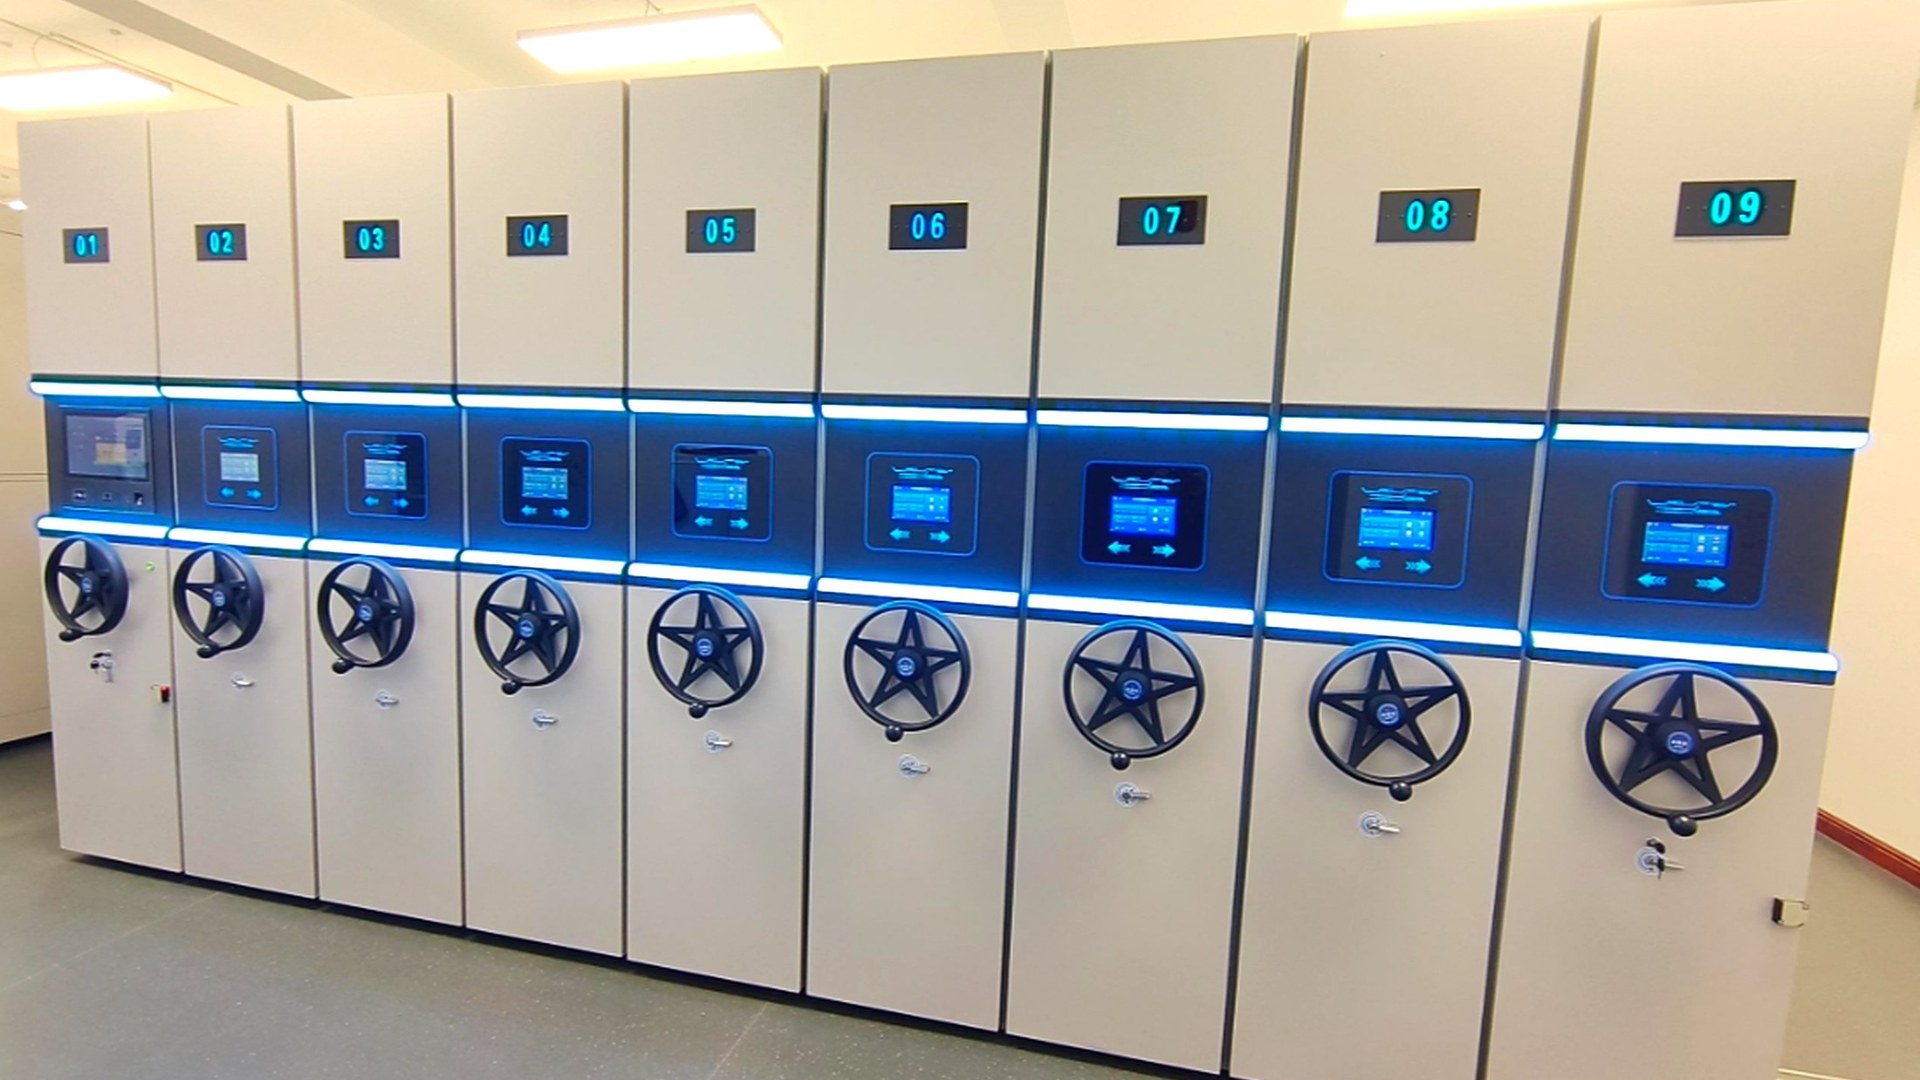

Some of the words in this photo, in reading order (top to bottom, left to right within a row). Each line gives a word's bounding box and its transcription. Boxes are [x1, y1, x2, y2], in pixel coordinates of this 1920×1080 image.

[1143, 205, 1181, 234] 07
[1405, 199, 1450, 231] 08
[1709, 190, 1761, 224] 09
[358, 227, 384, 251] 03
[523, 223, 551, 248] 04
[705, 217, 736, 244] 05
[911, 212, 945, 240] 06
[76, 235, 97, 256] 01
[209, 230, 234, 254] 02
